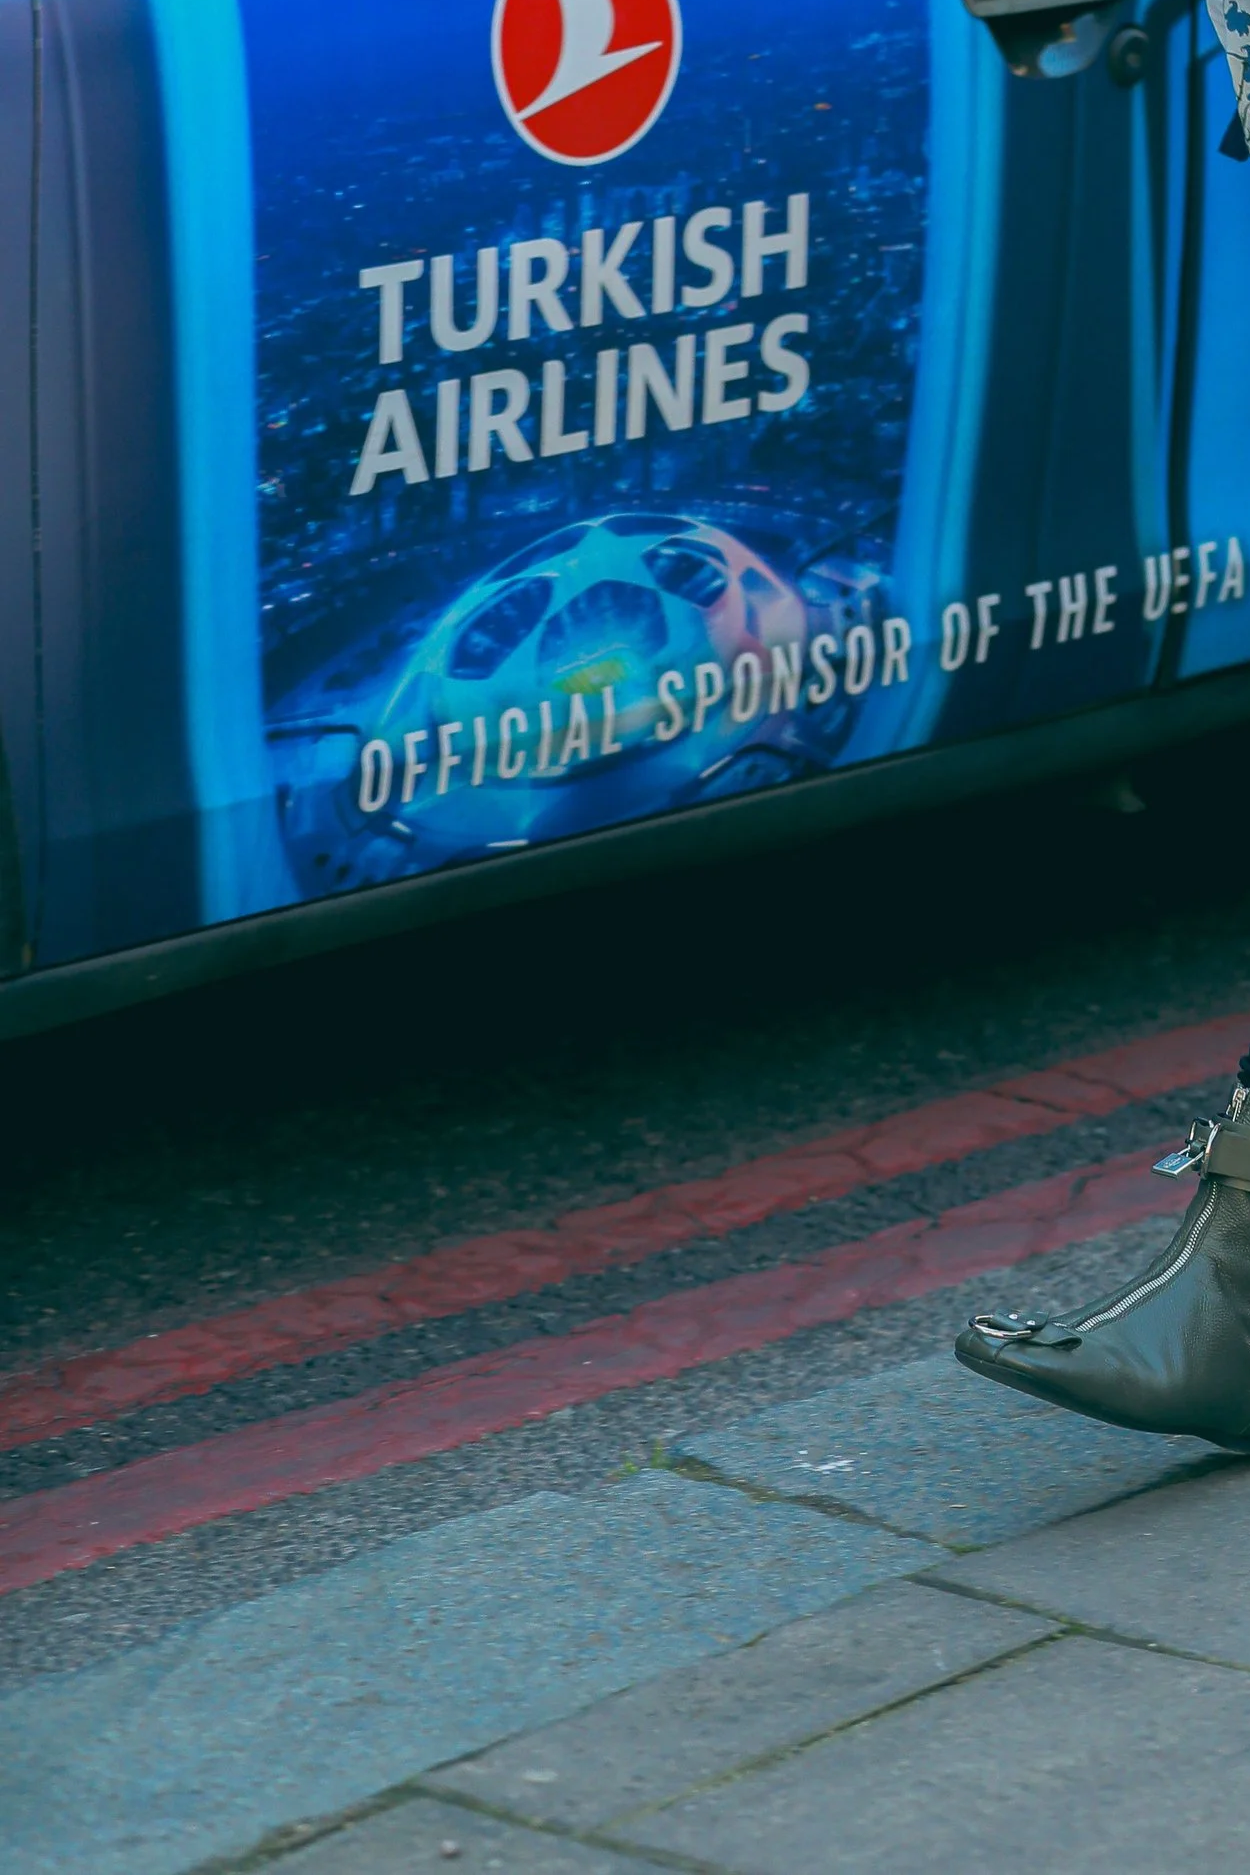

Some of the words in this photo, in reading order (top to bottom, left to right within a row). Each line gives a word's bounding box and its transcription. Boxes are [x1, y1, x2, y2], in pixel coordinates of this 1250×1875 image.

[358, 192, 810, 365] TURKISH
[348, 313, 811, 496] AIRLINES
[357, 685, 624, 814] OFFICIAL
[653, 616, 913, 742] SPONSOR
[940, 593, 1001, 672] OF
[1025, 565, 1118, 650] THE
[1142, 536, 1246, 622] UEFA
